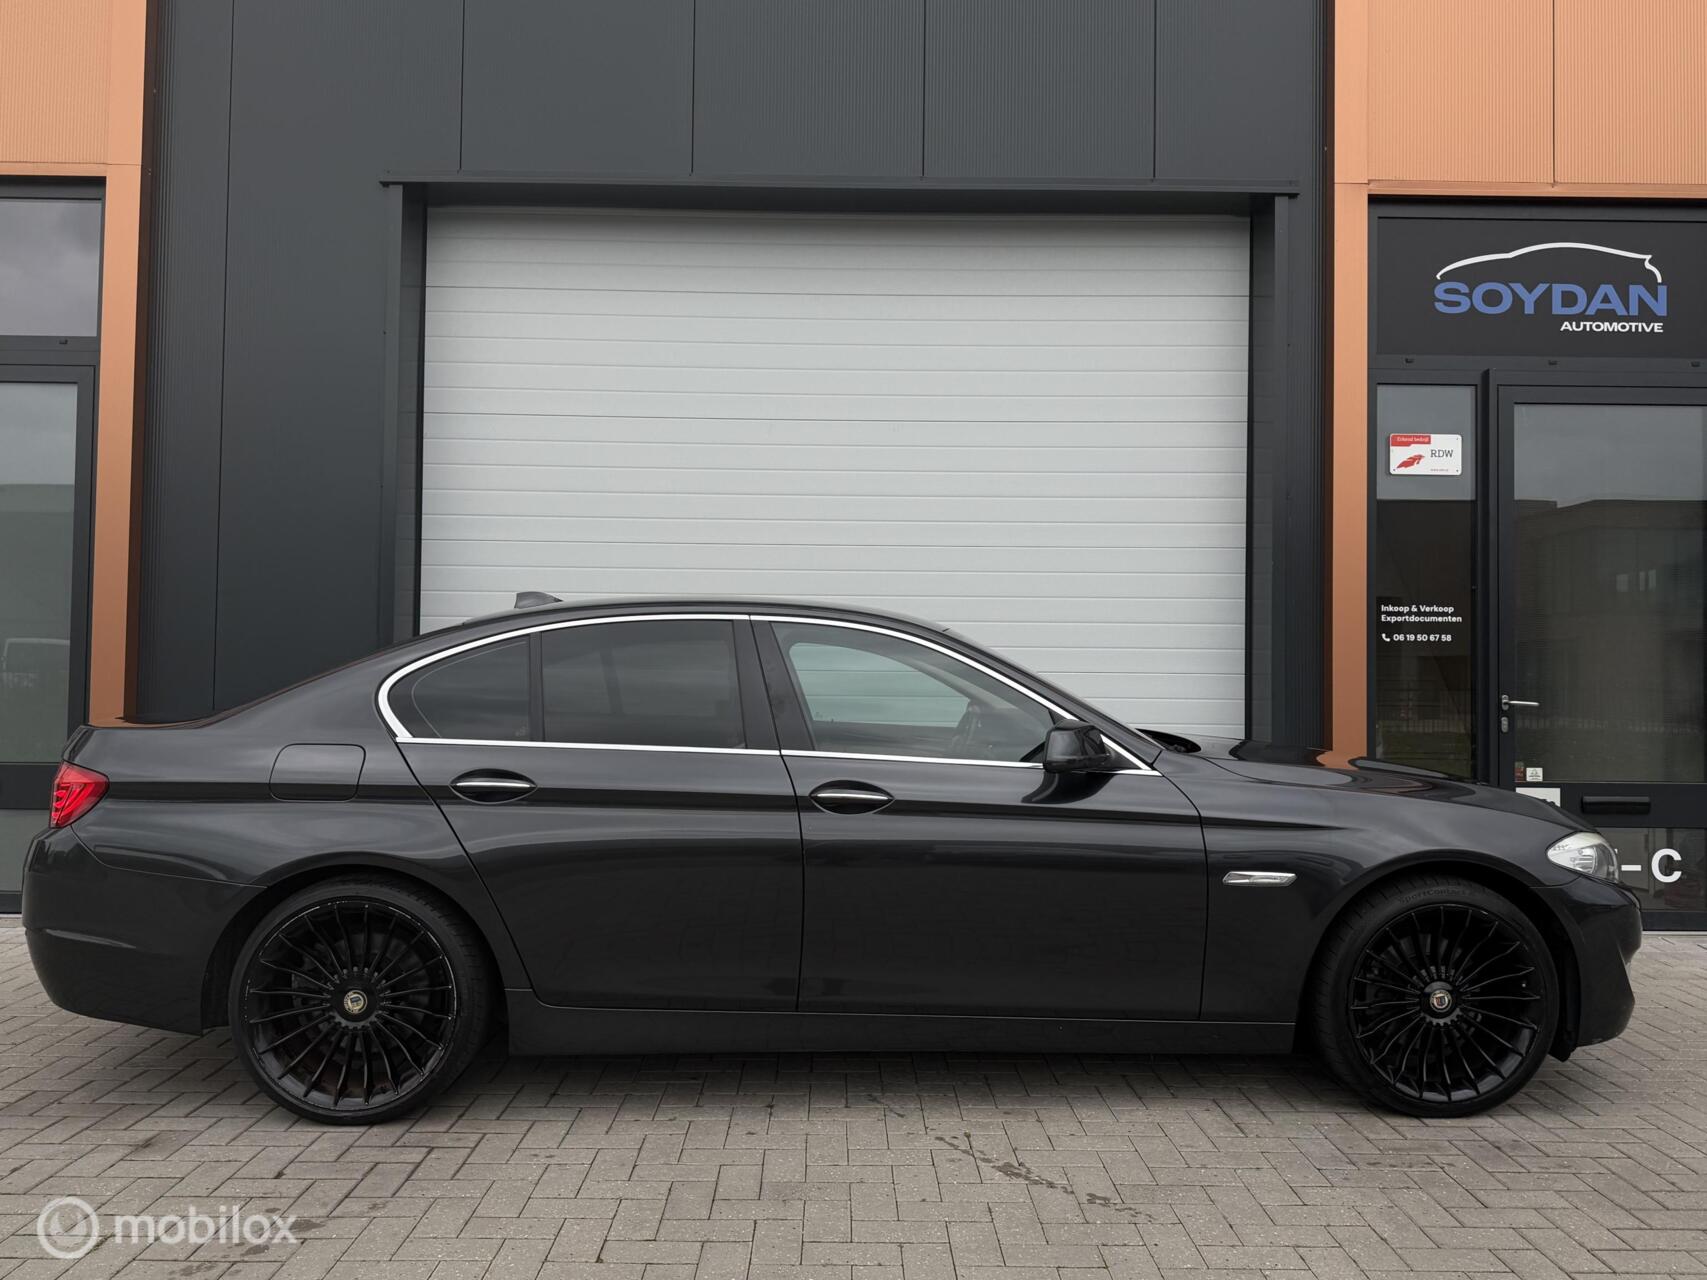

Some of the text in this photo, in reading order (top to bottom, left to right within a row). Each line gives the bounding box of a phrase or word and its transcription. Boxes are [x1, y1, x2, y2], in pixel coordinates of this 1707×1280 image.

[1433, 281, 1668, 317] SOYDAN
[1559, 321, 1664, 333] AUTOMOTIVE
[1430, 449, 1454, 458] RDW
[1381, 604, 1455, 614] Inkoop & Verkoop
[1381, 614, 1463, 624] Exportdocumenten
[1393, 633, 1452, 642] 06 19 50 67 58
[1651, 848, 1682, 883] C
